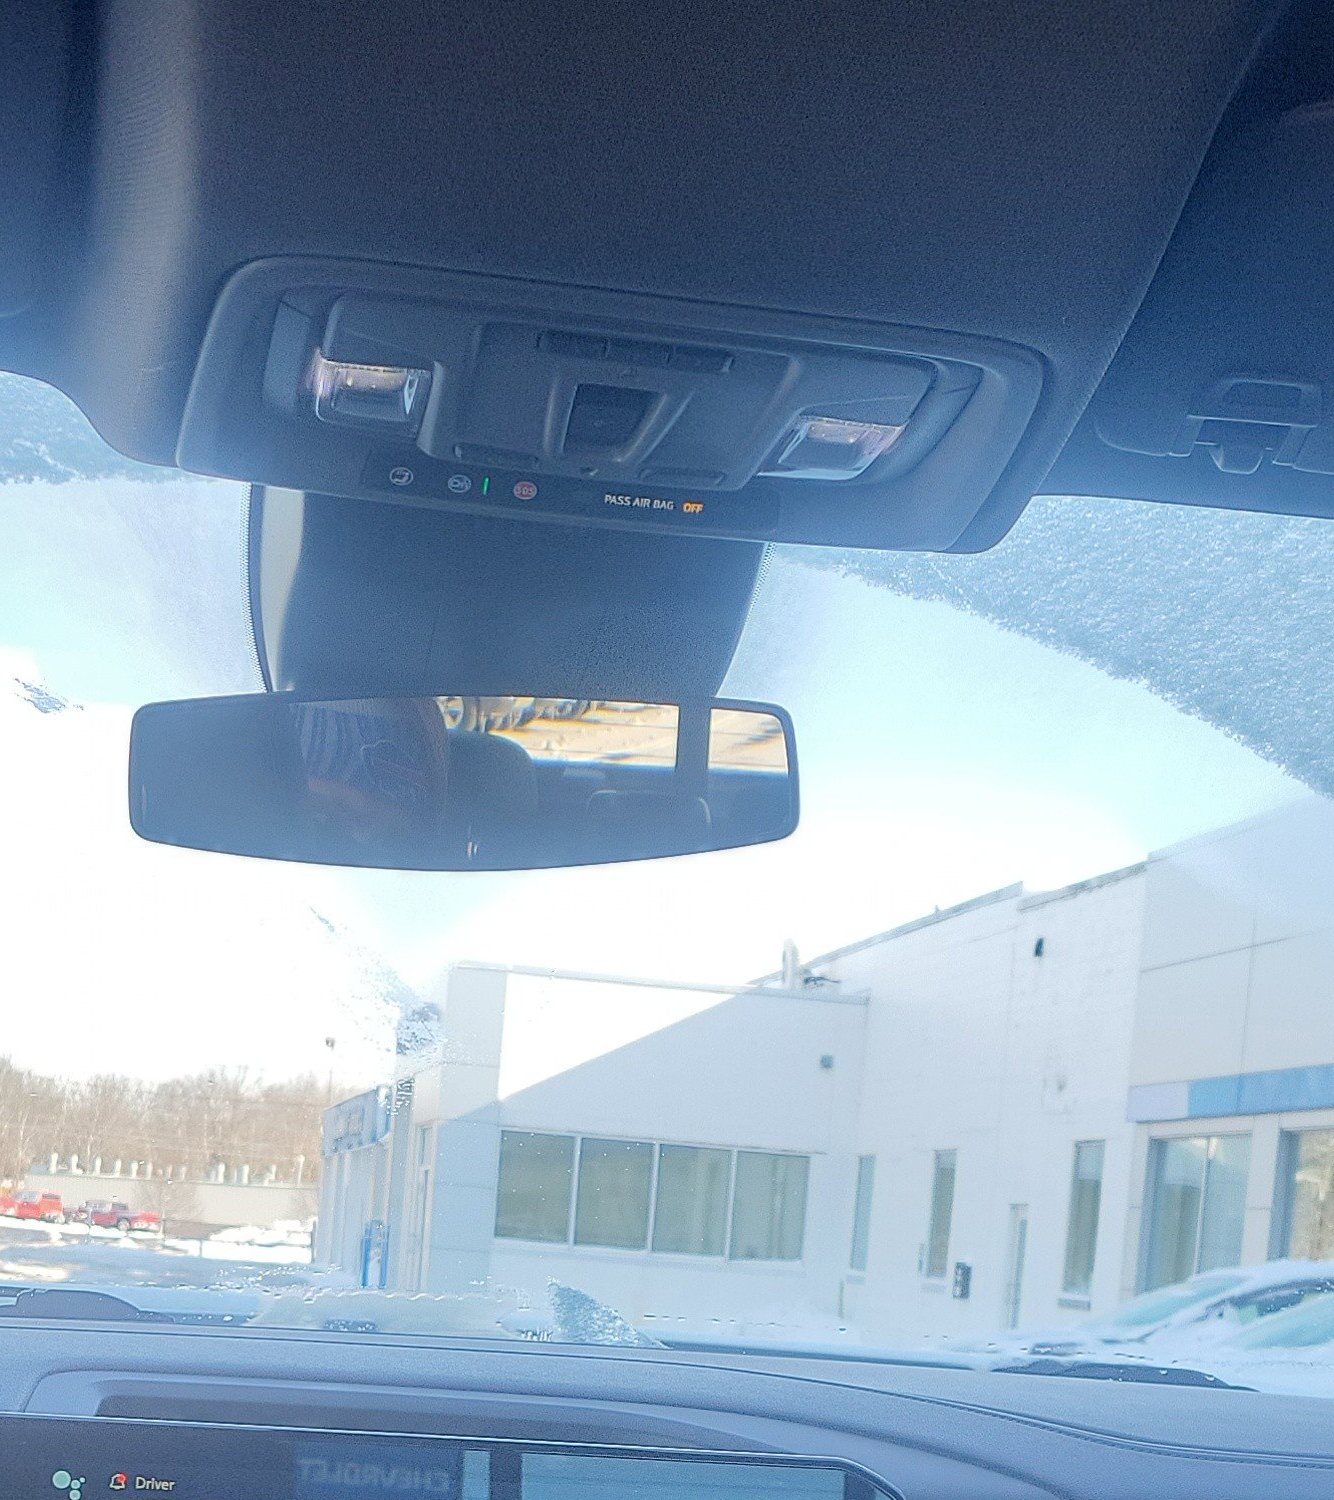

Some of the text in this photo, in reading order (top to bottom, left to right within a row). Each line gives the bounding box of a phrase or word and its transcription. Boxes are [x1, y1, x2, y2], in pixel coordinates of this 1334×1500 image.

[603, 493, 704, 514] PASS AIR BAG OFF
[134, 1475, 175, 1492] Driver
